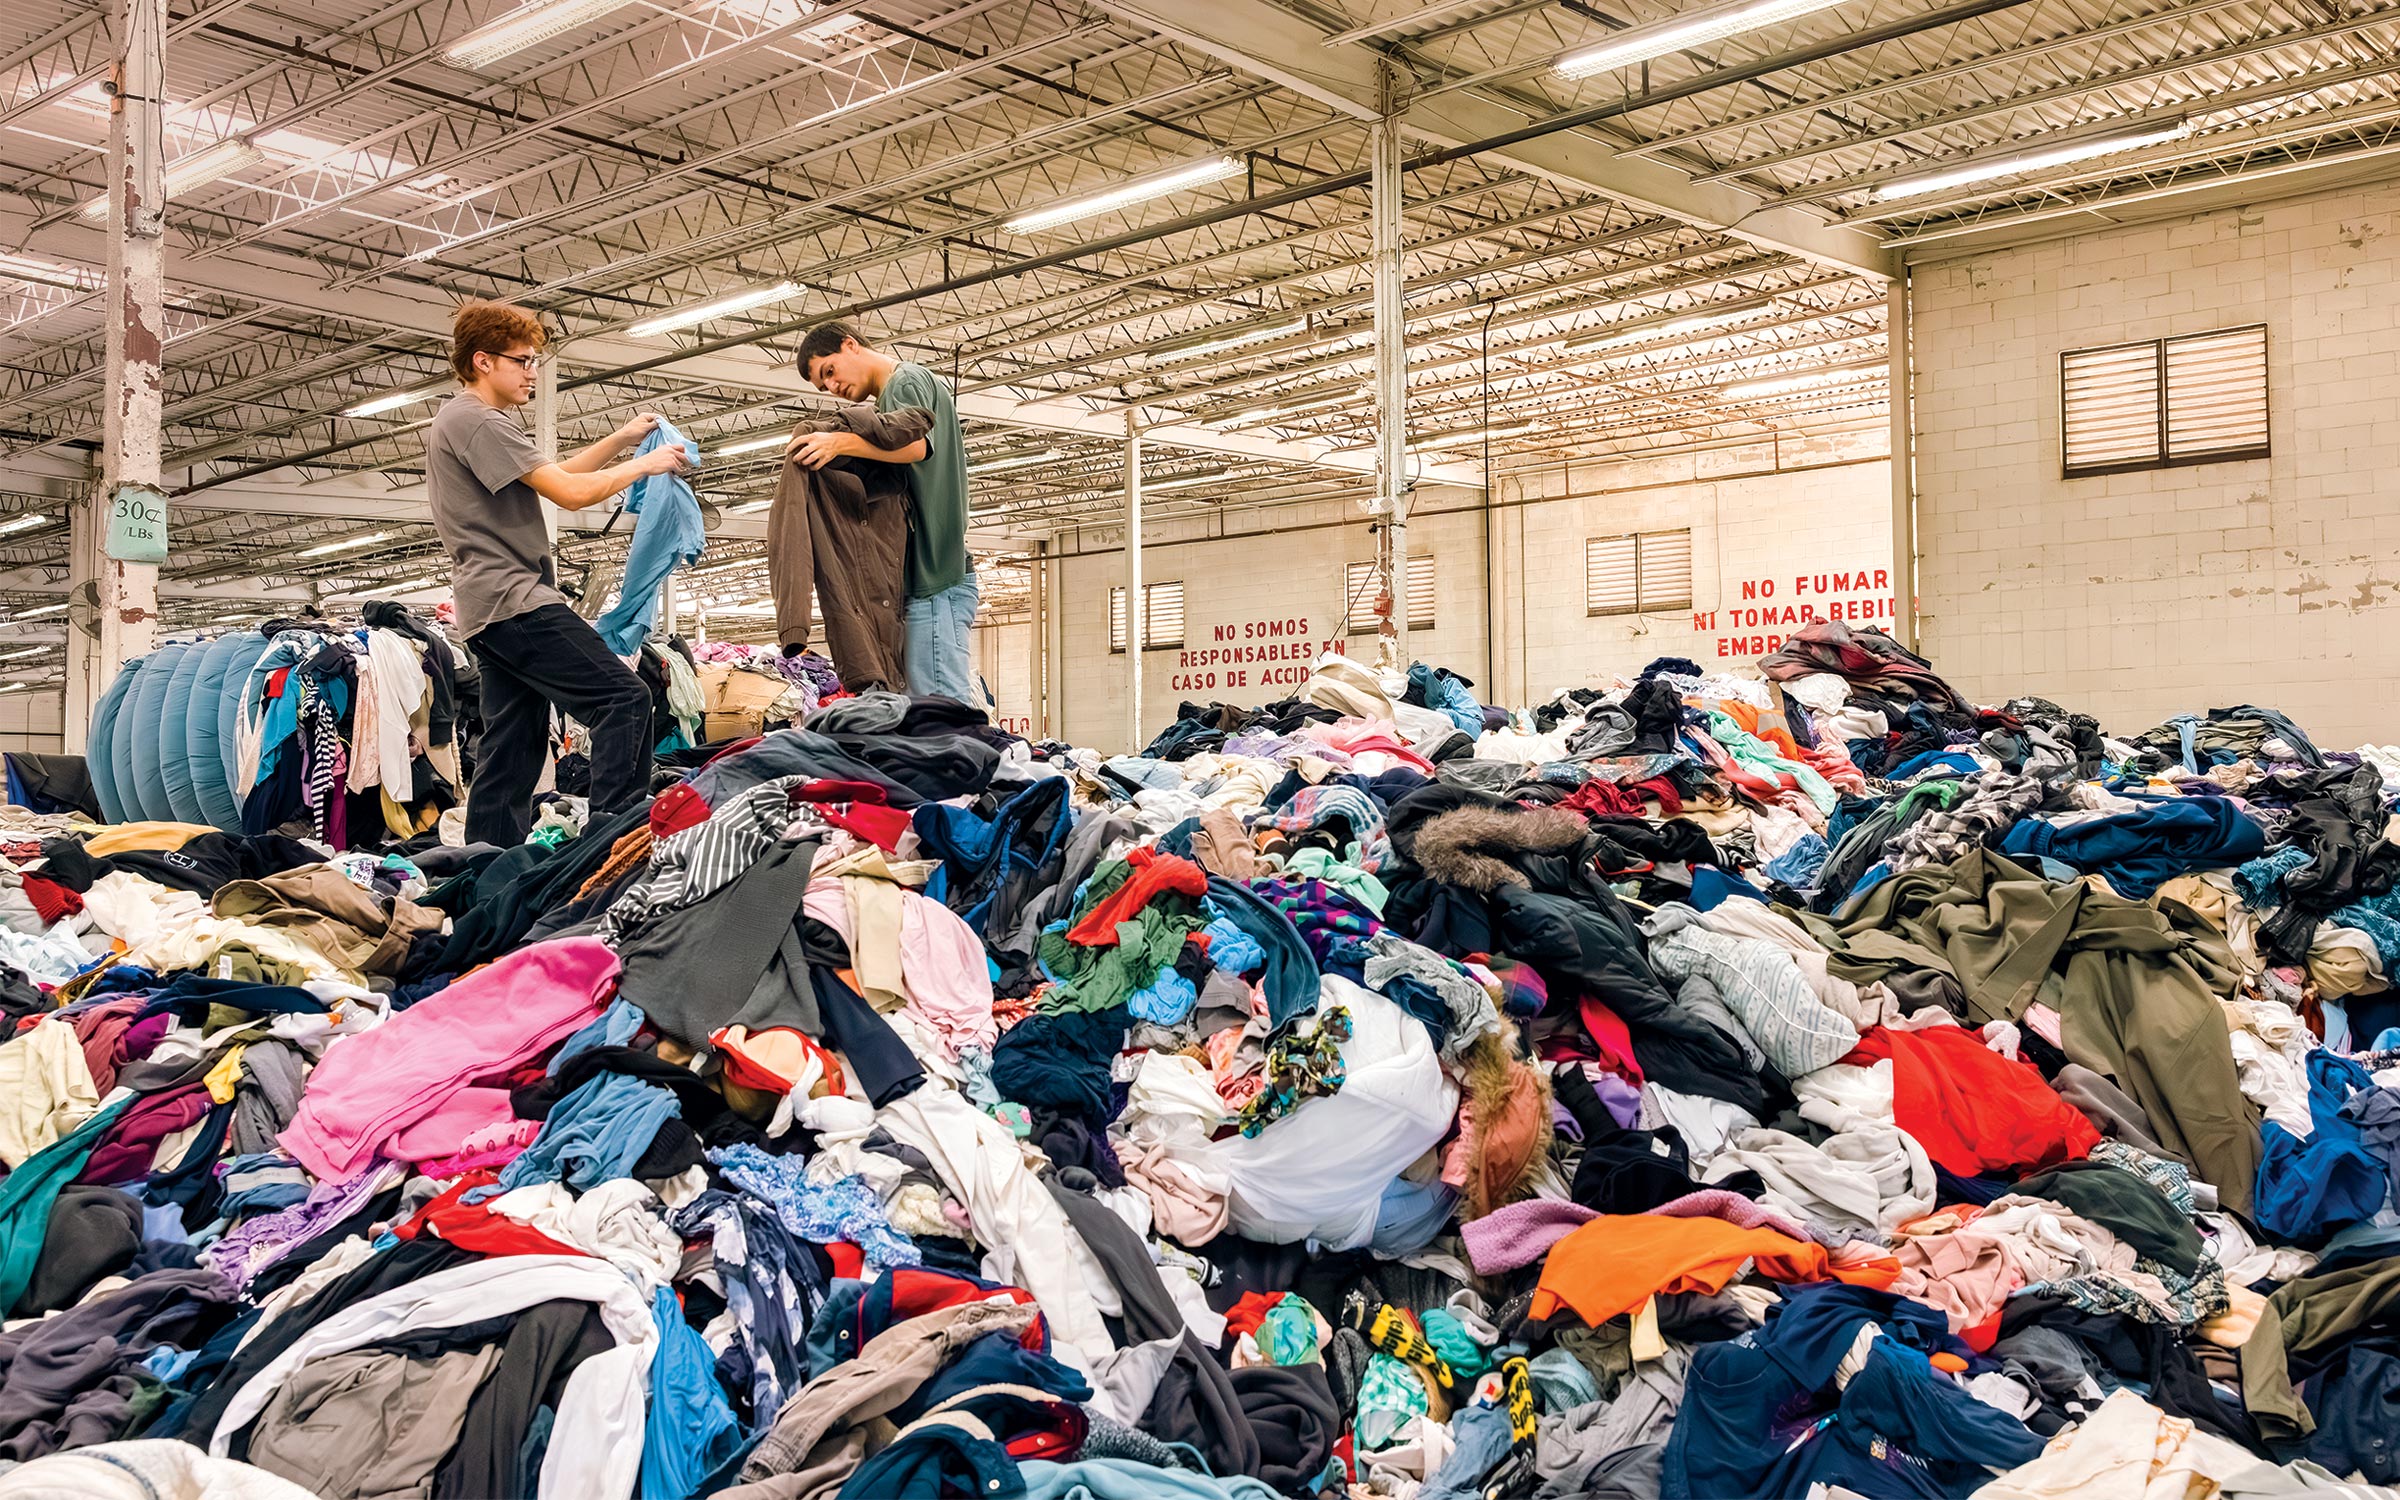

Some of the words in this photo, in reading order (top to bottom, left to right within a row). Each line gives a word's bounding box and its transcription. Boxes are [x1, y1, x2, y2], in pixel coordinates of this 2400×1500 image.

[1742, 580, 1775, 600] NO
[1796, 569, 1888, 595] FUMAR
[1214, 624, 1236, 641] NO
[1245, 618, 1308, 639] SOMOS
[1693, 611, 1715, 631] NI
[1729, 604, 1814, 628] TOMAR
[1180, 642, 1312, 668] RESPONSABLES
[1322, 639, 1345, 656] EN
[1172, 672, 1216, 691] CASO
[1226, 670, 1247, 688] DE
[1260, 666, 1310, 686] ACCID
